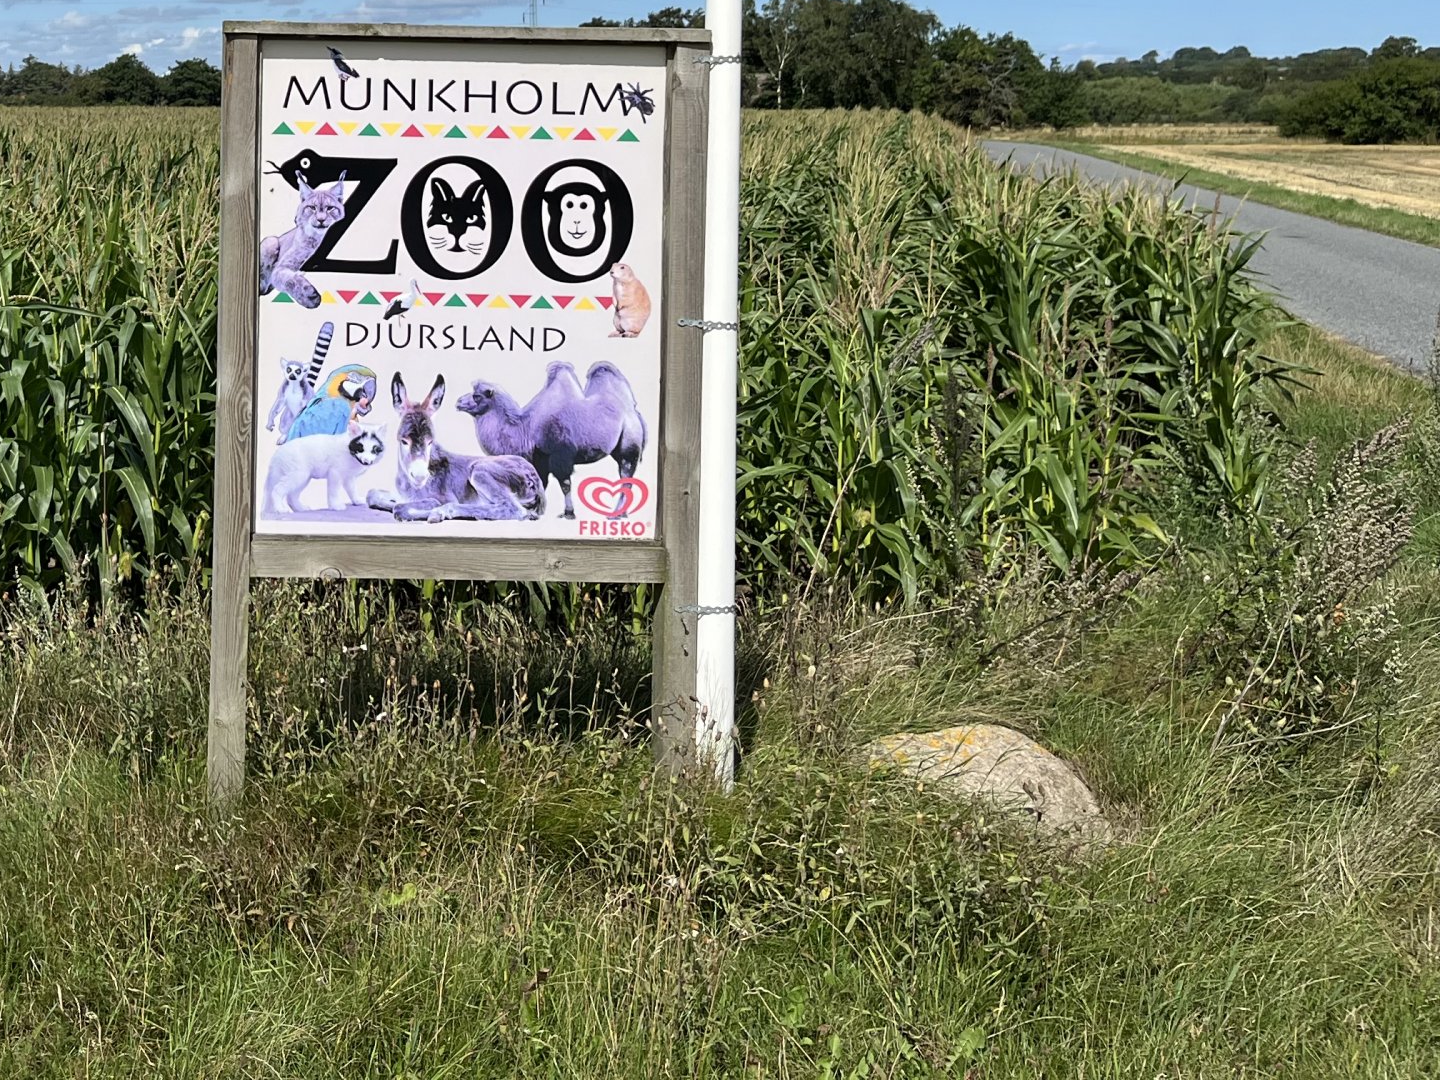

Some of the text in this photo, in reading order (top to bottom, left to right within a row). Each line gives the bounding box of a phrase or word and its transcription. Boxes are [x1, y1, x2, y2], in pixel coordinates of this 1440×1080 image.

[283, 75, 632, 117] MUNKHOLM
[276, 148, 634, 284] ZOO
[346, 322, 567, 352] DJURSLAND
[579, 520, 645, 536] FRISKO
